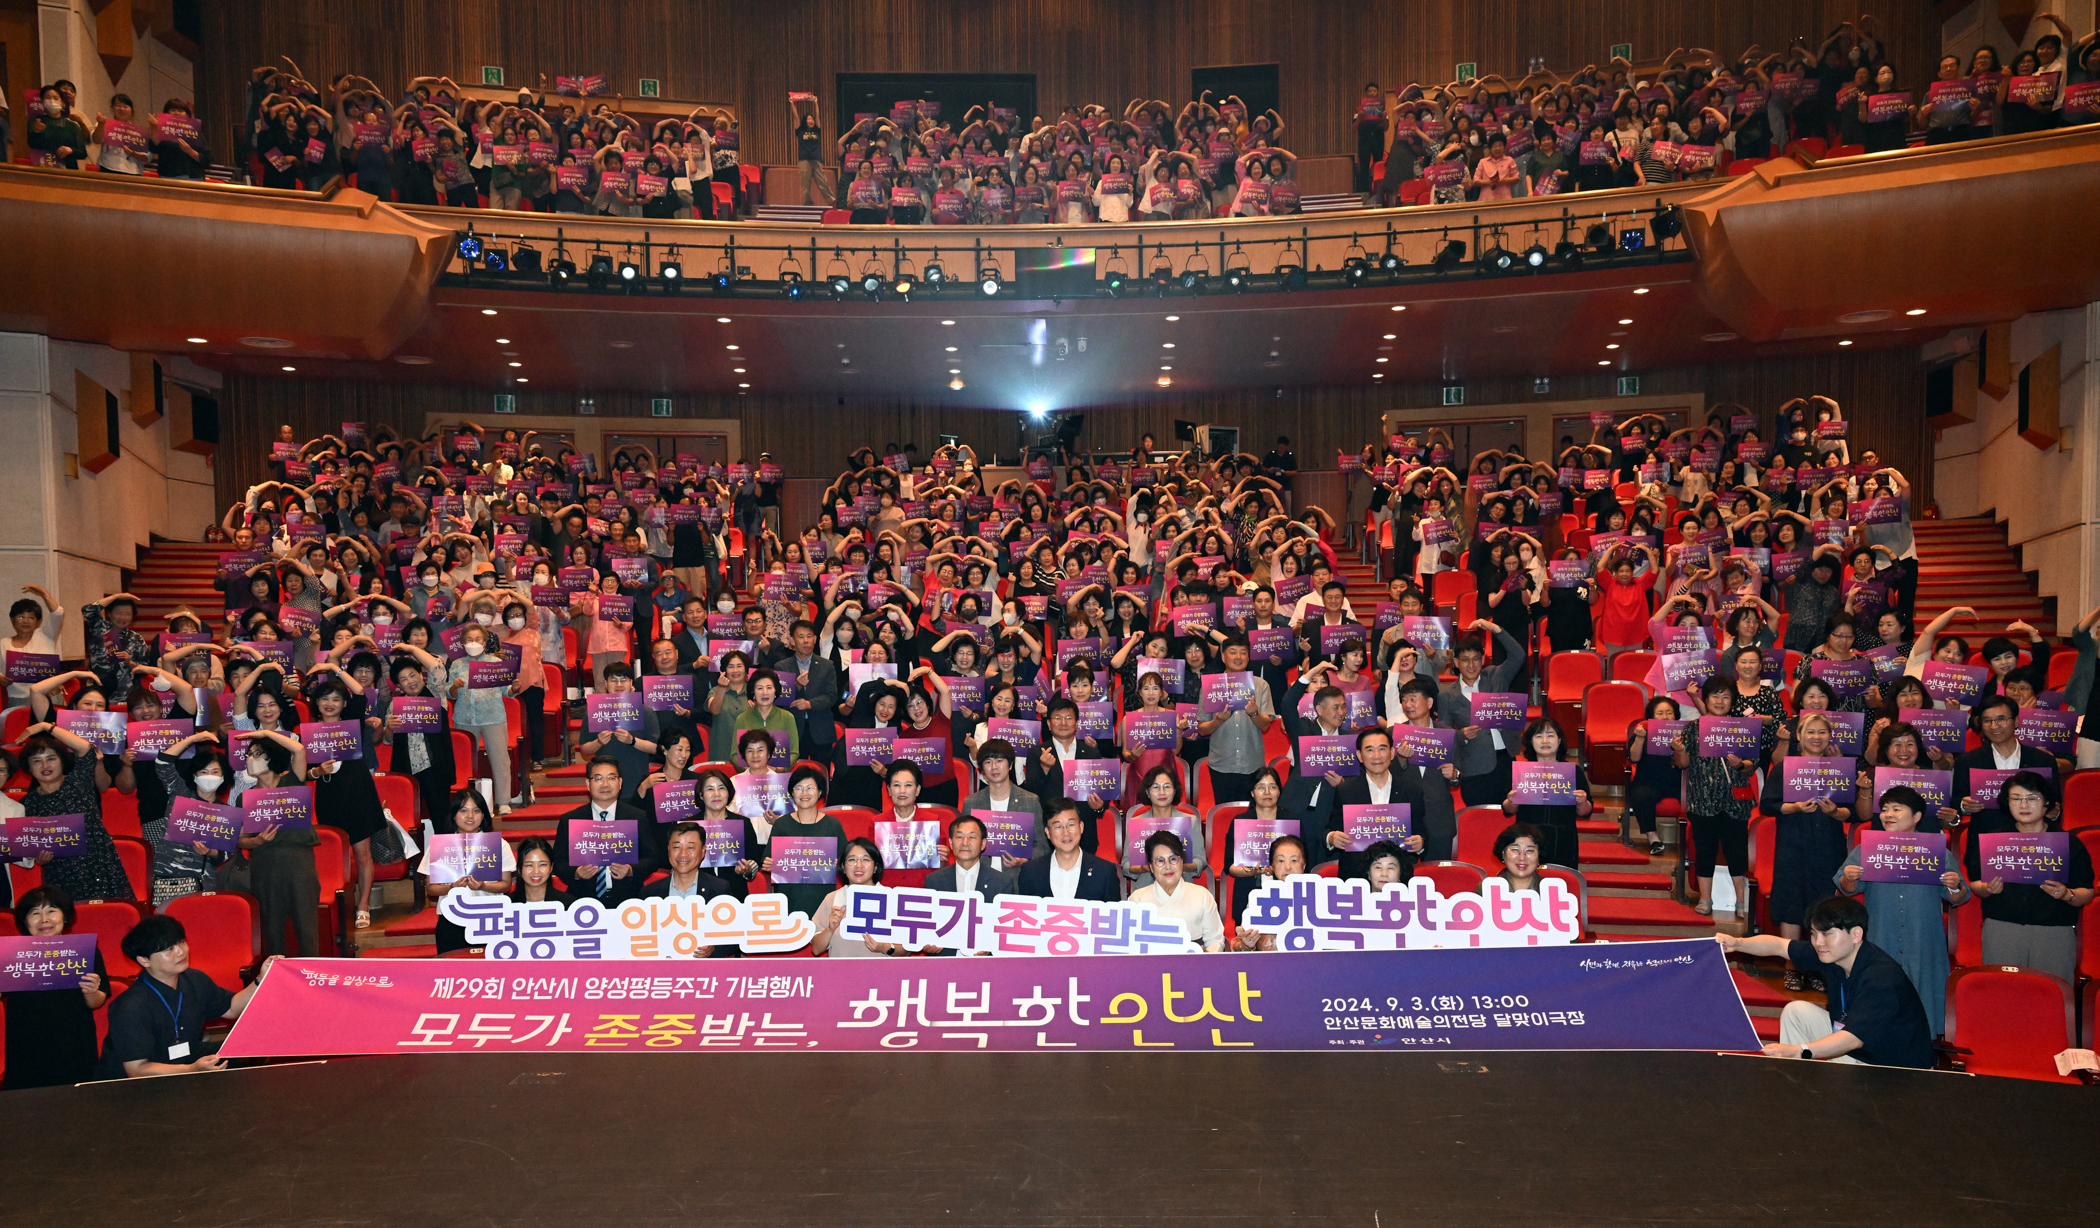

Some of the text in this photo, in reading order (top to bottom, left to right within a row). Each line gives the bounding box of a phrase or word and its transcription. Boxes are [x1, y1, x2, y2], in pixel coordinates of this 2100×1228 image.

[1736, 735, 1756, 747] 안산
[1336, 753, 1355, 765] 안산
[1098, 776, 1116, 790] 안산
[1550, 780, 1571, 794] 안산
[1826, 777, 1850, 791] 안산
[186, 810, 204, 818] 모두가
[284, 806, 307, 818] 안산
[210, 826, 234, 840] 안산
[1384, 824, 1406, 838] 안산
[54, 833, 80, 846] 안산
[610, 839, 633, 853] 안산
[1900, 845, 1930, 854] 존중받는,
[2021, 846, 2054, 854] 존중받는,
[810, 858, 832, 872] 안산
[1867, 854, 1939, 871] 행복한 안산
[1987, 855, 2062, 872] 행복한 안산
[847, 892, 982, 949] 모두가
[1250, 882, 1570, 950] 행복한 안산
[449, 894, 808, 959] 평등을 일상으로
[16, 950, 78, 958] 모두가 존중받는,
[4, 958, 87, 978] 행복한 안산
[301, 969, 394, 988] 평등을 일상으로
[430, 976, 814, 1000] 제29회 안산시 양성평등주간 기념행사
[1322, 994, 1529, 1012] 2024. 9. 3.(화) 13:00
[838, 972, 1262, 1049] 행복한 안산
[1324, 1011, 1586, 1030] 안산문화예술의전당 달맞이극장
[397, 1013, 820, 1049] 모두가 존중받는,
